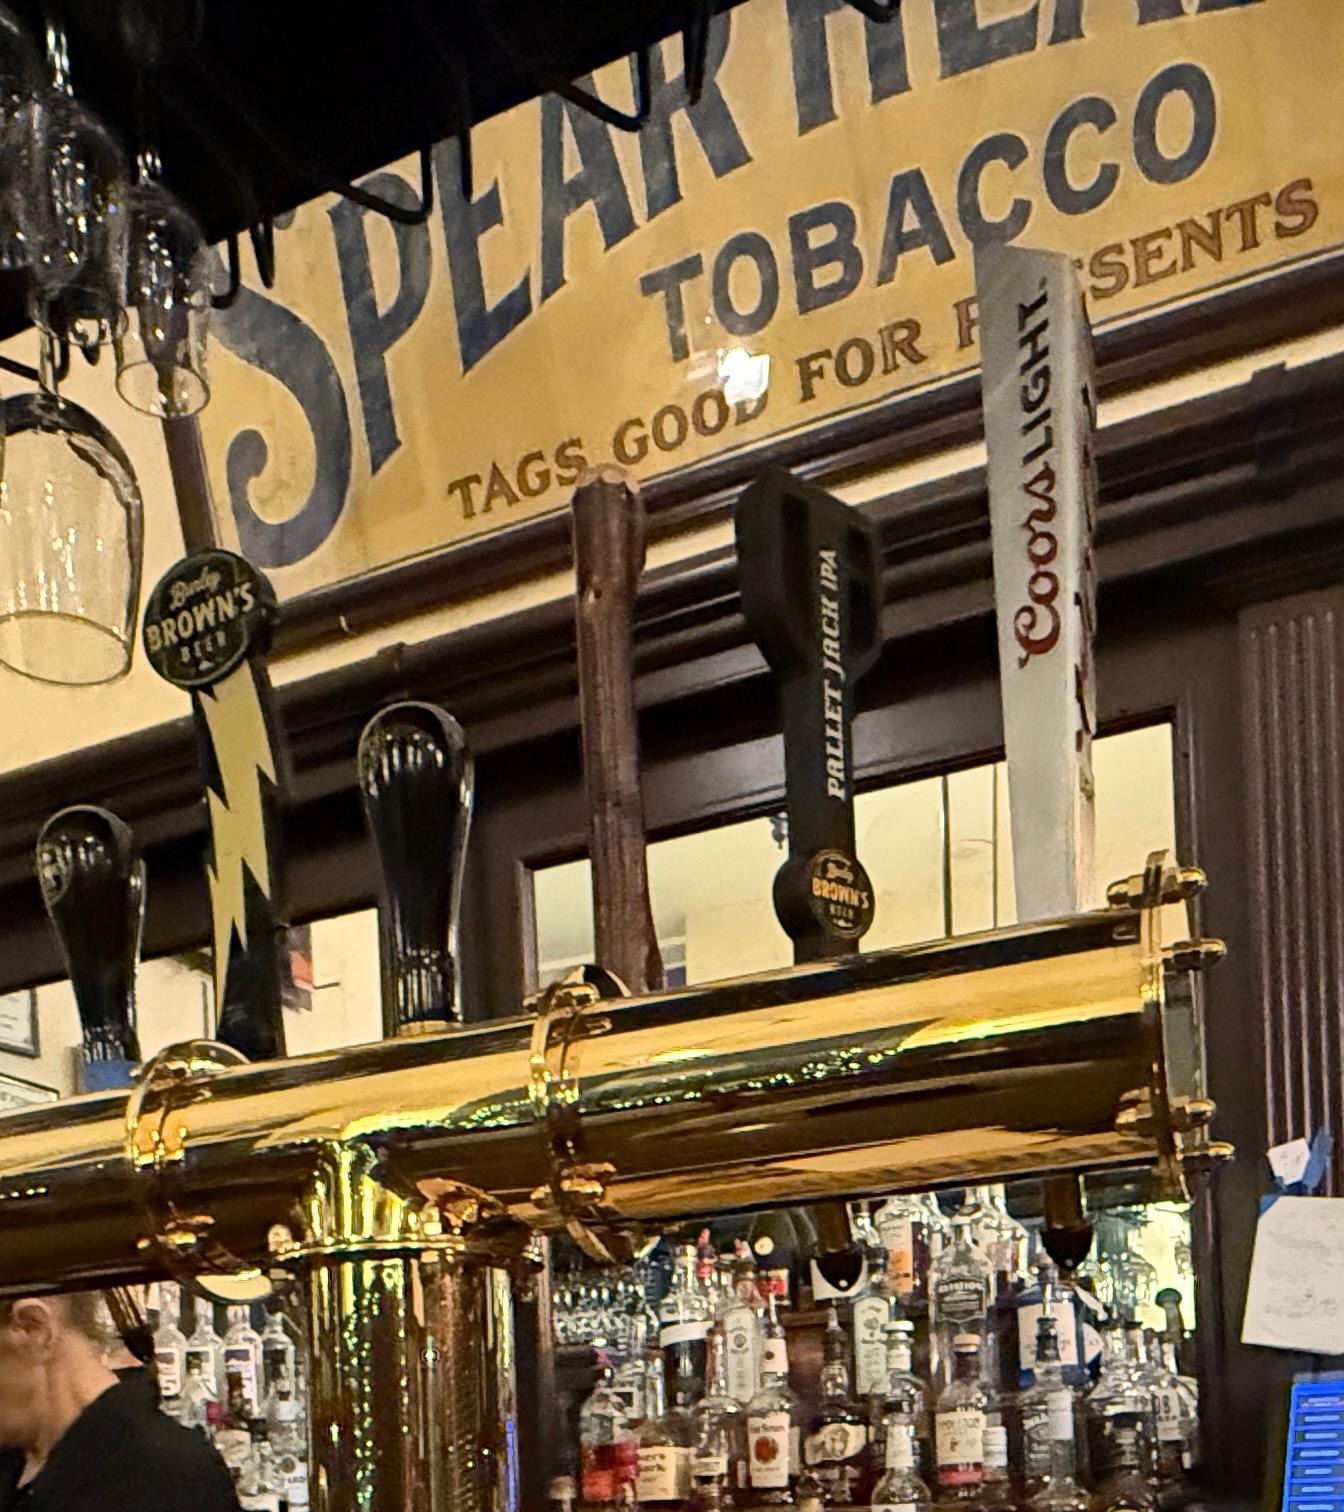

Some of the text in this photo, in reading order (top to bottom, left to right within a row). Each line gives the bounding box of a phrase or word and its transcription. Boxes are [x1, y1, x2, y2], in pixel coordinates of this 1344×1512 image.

[640, 63, 1217, 362] TOBACCO
[448, 438, 587, 519] TAGS
[798, 319, 928, 402] FOR
[1013, 288, 1061, 669] Coors LIGHT
[145, 582, 255, 653] BROWN'S
[819, 548, 846, 801] PALLET JACK IPA
